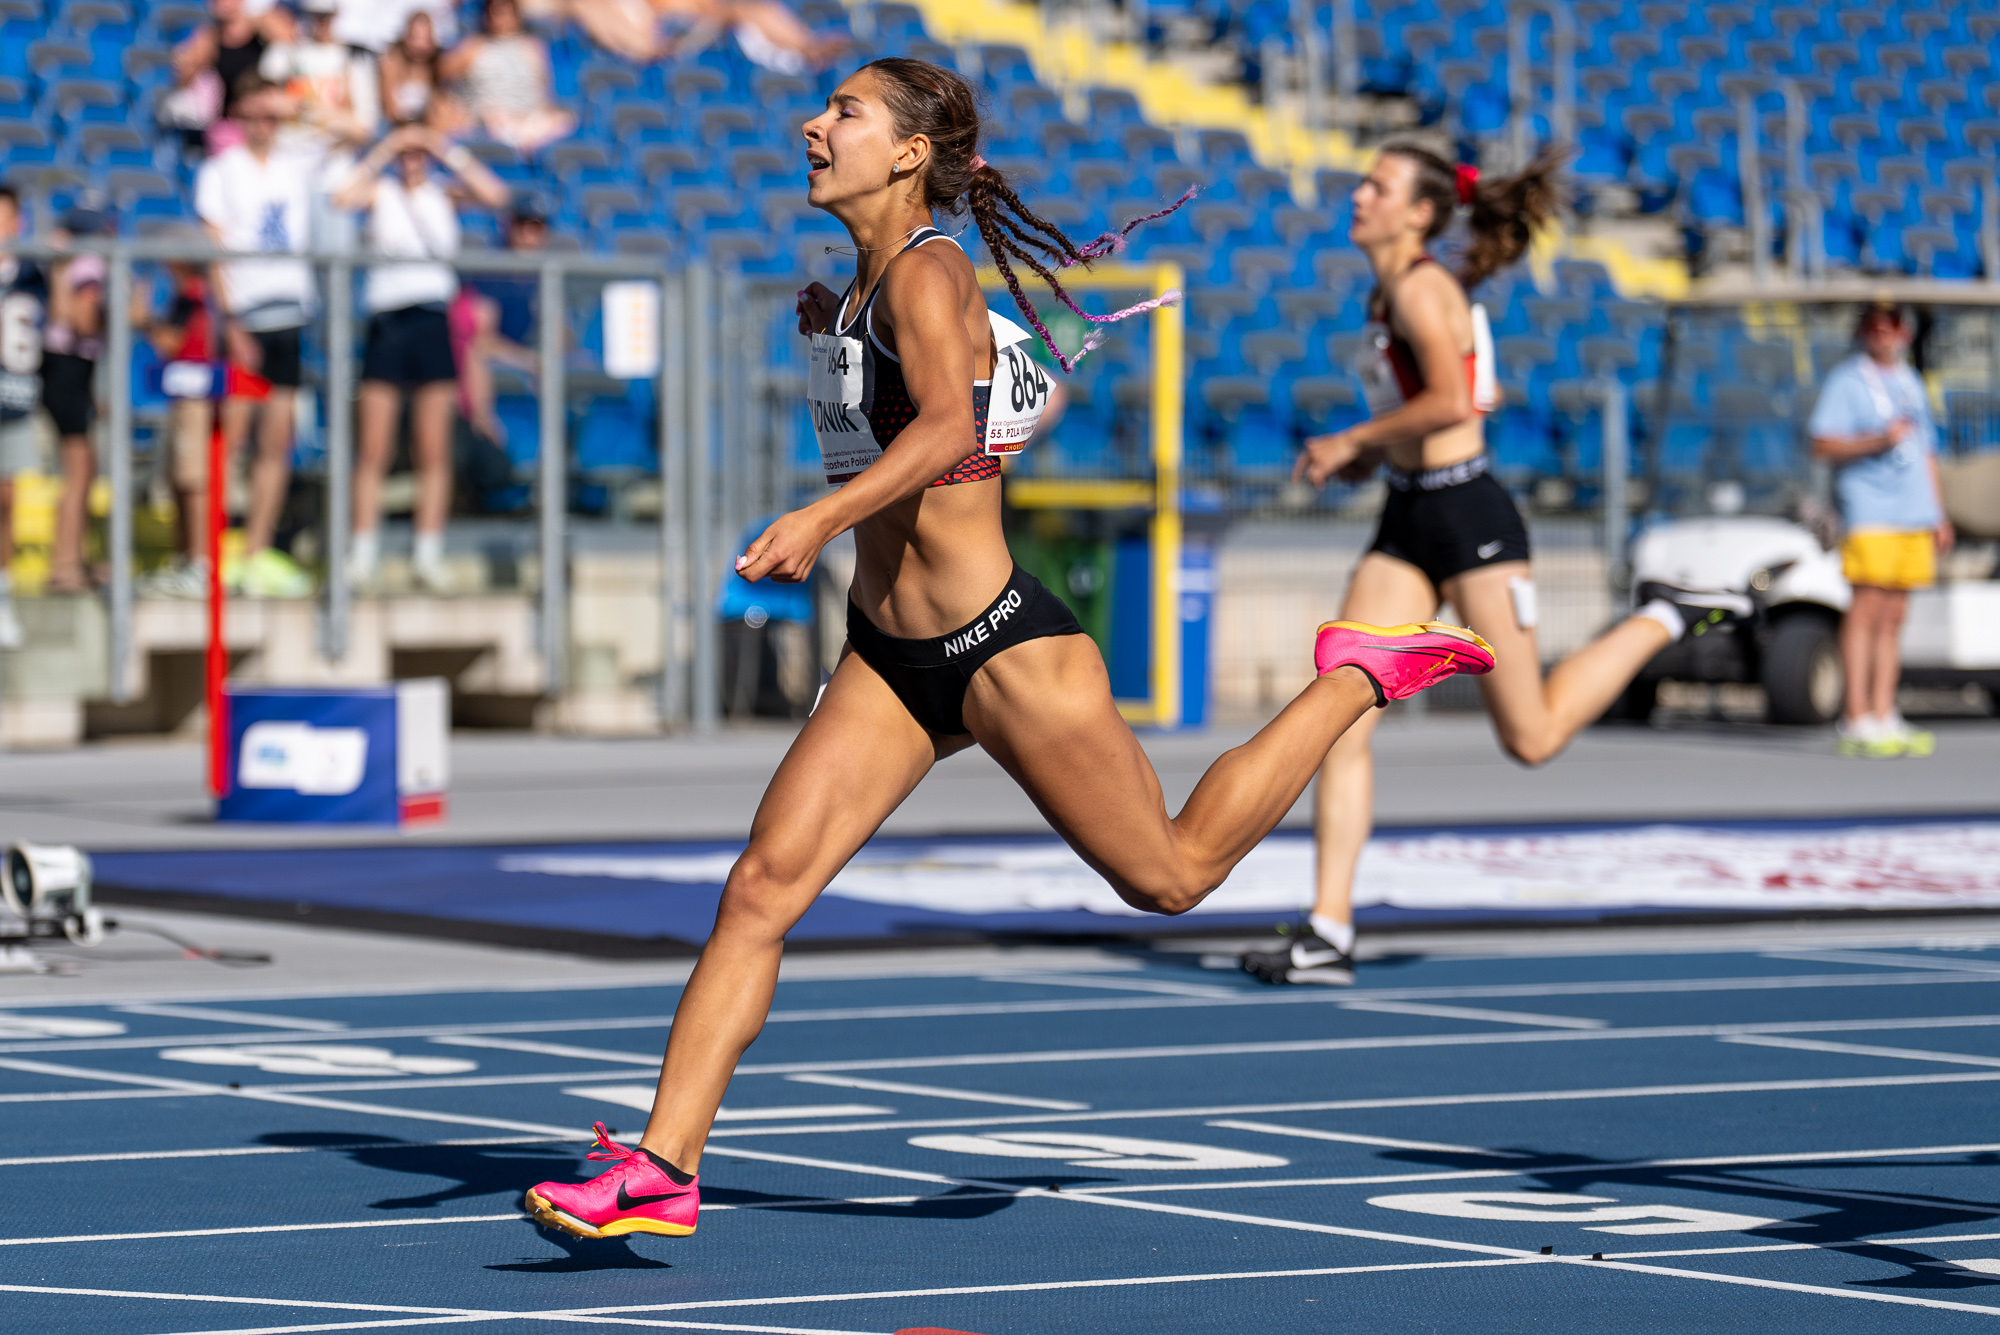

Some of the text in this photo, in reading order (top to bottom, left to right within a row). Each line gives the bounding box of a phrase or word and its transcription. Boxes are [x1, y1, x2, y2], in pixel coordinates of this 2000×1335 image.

[1008, 351, 1048, 413] 864
[990, 428, 1004, 439] 55.
[1006, 427, 1020, 438] PZLA
[851, 455, 872, 468] Polski
[943, 589, 1022, 658] NIKE PRO
